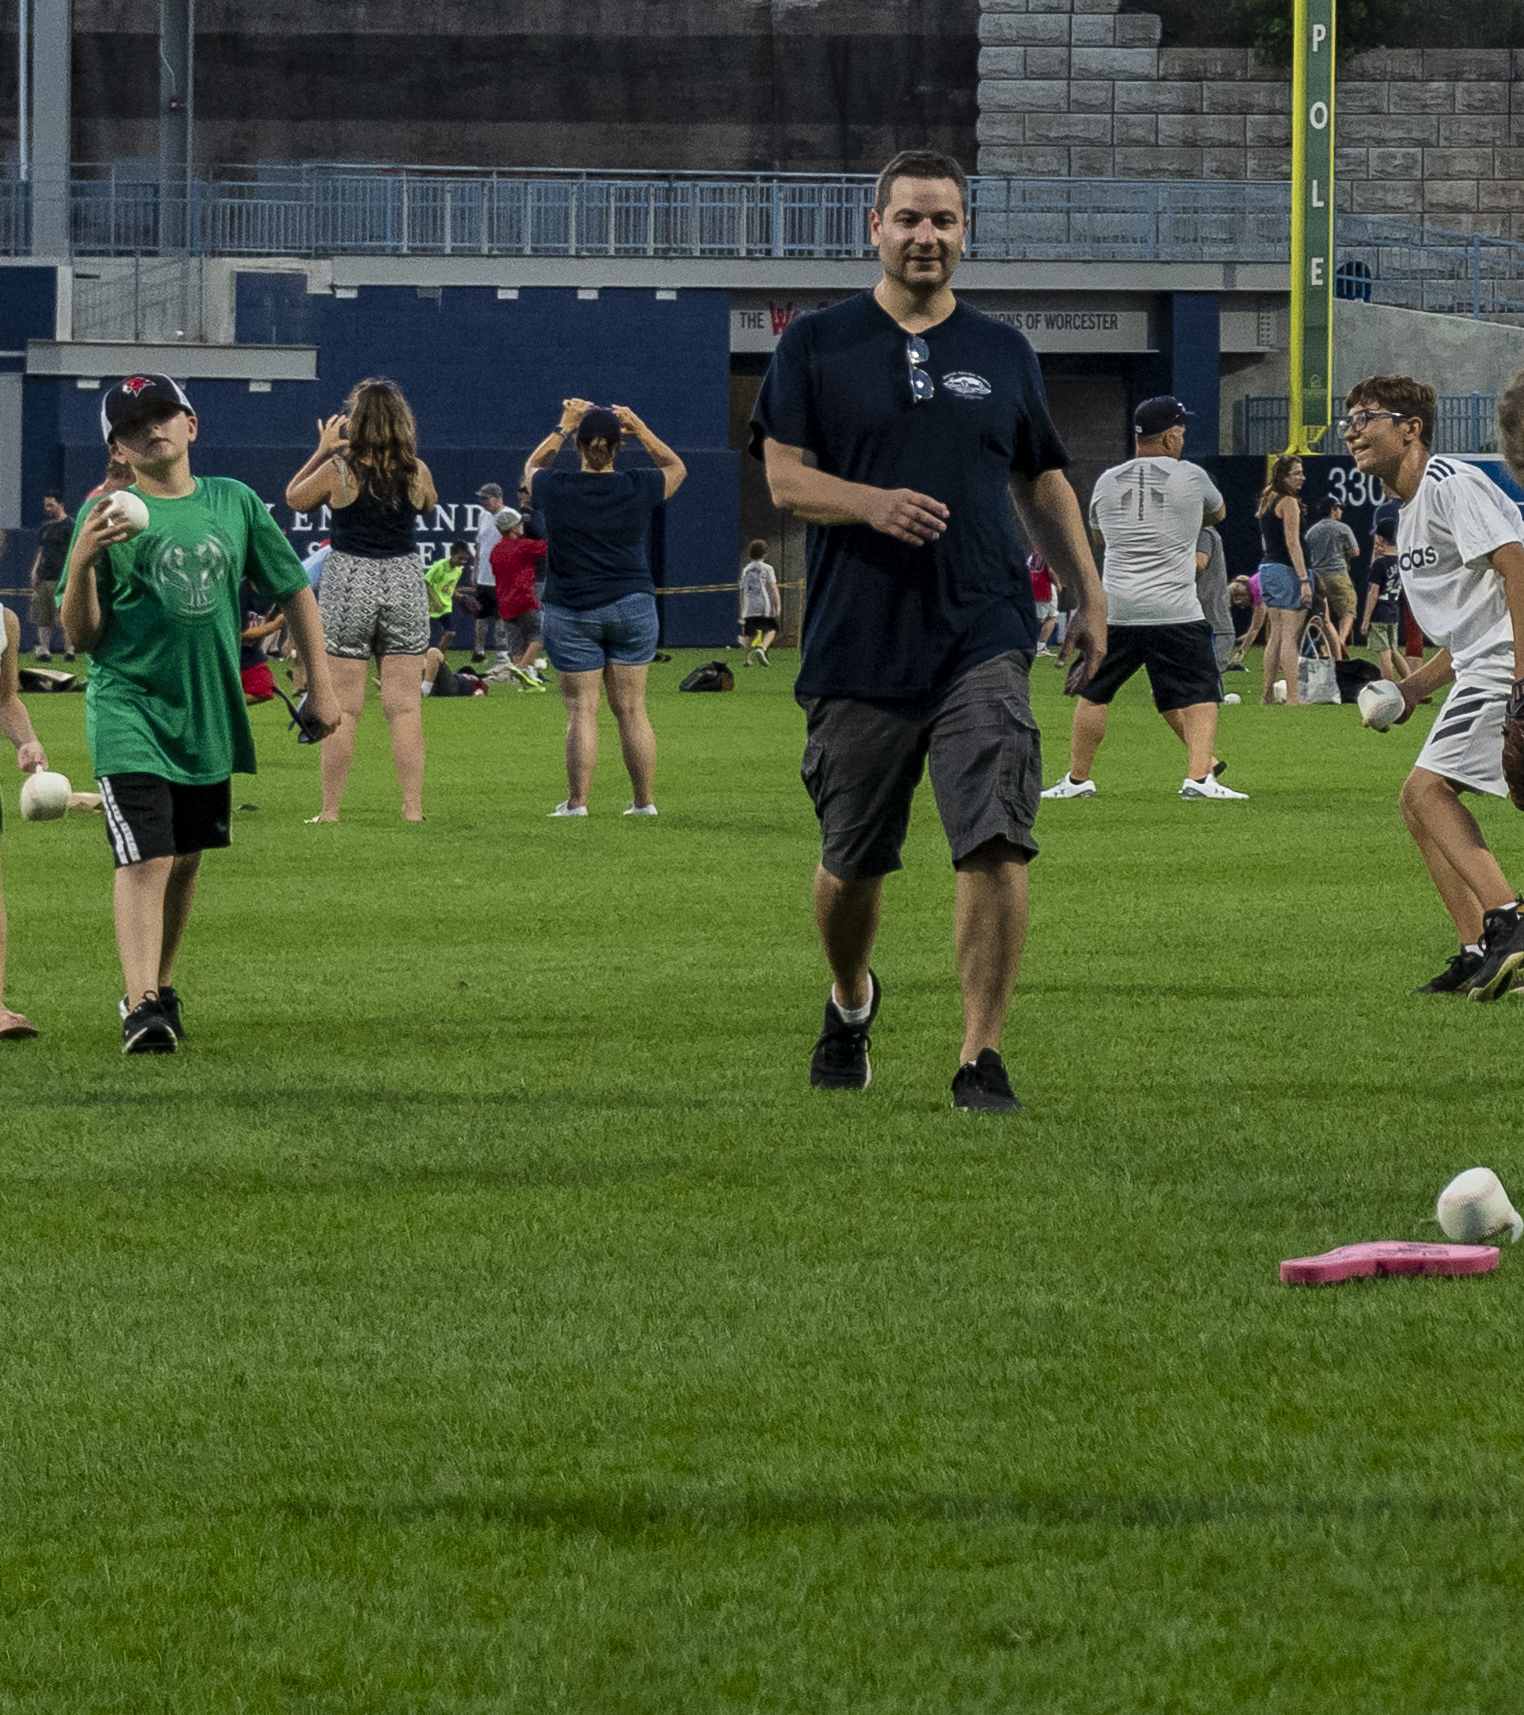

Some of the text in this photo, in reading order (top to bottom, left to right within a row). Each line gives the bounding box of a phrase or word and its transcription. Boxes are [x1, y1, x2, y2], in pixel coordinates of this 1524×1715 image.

[1309, 23, 1328, 287] POLE
[739, 311, 765, 329] THE
[1026, 312, 1042, 330] OF
[1044, 312, 1119, 331] WORCESTER
[1327, 466, 1386, 507] 330
